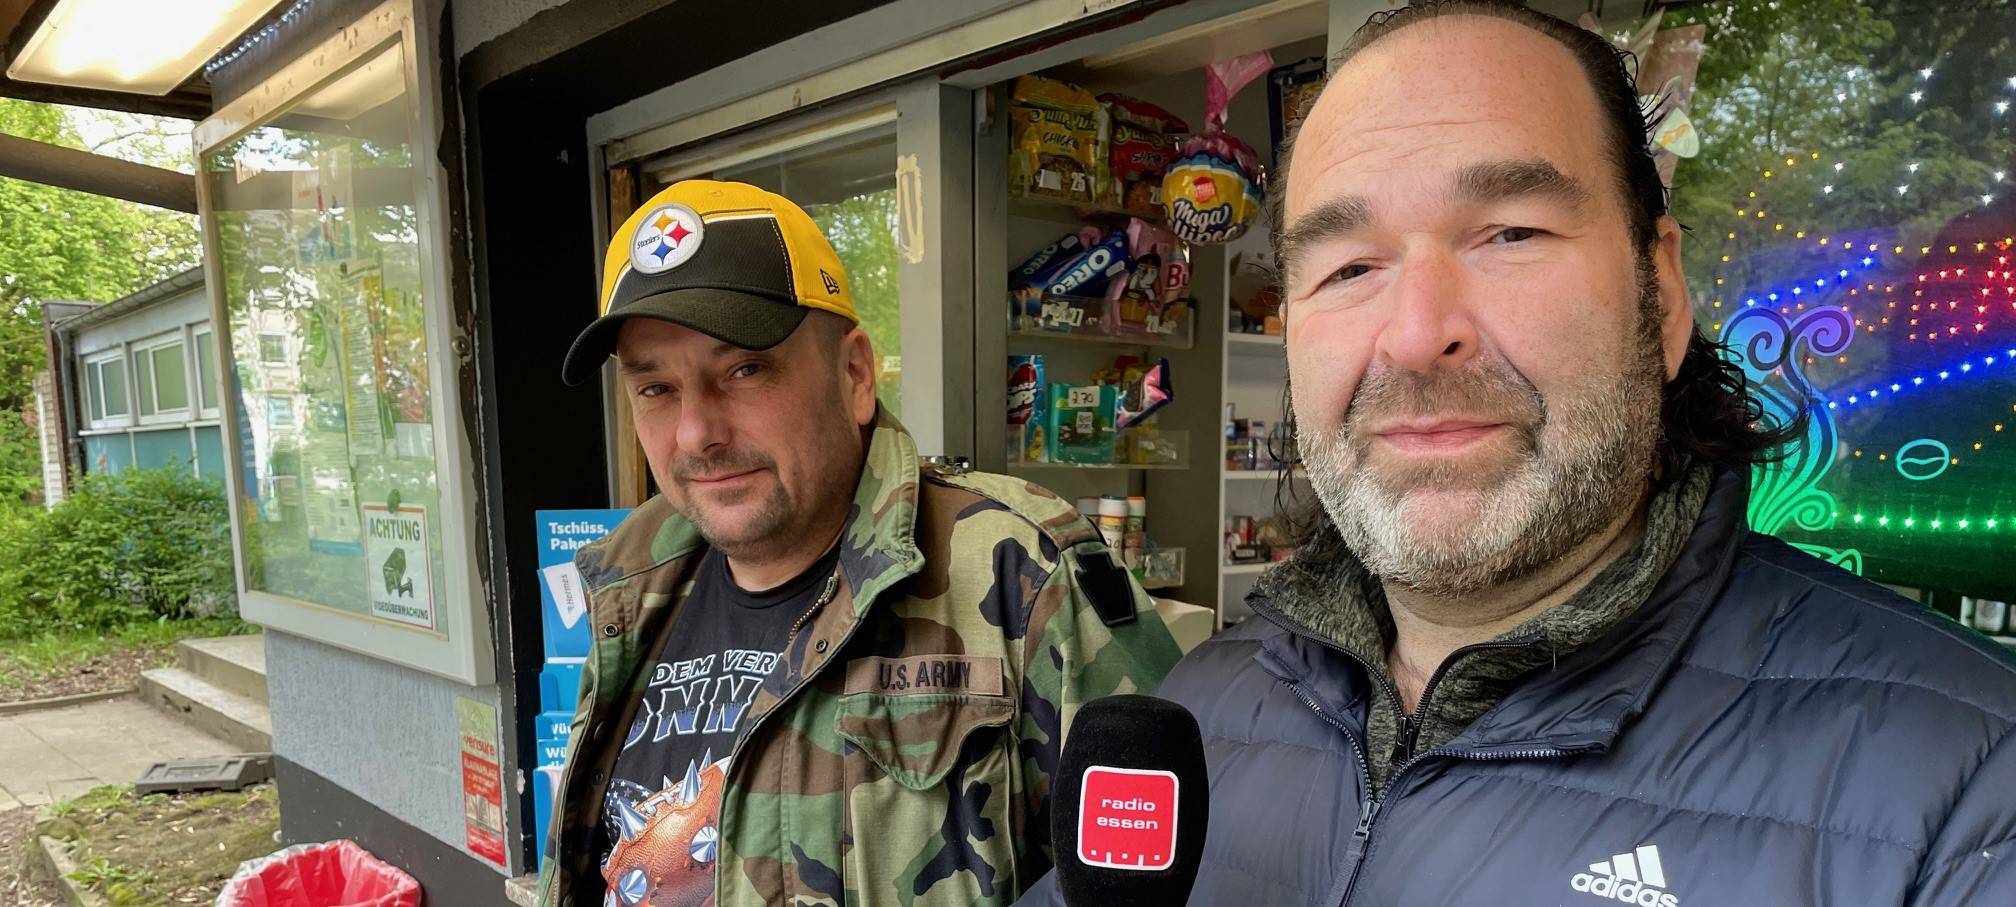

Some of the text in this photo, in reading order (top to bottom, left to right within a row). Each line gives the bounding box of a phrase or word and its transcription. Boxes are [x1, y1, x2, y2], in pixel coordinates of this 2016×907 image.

[1174, 200, 1230, 234] Mega
[1051, 248, 1112, 296] OREO
[369, 517, 421, 541] ACHTUNG
[548, 521, 609, 535] Tschüss,
[373, 600, 429, 621] VIDEOÜBERWACHUNG
[649, 649, 783, 687] DEM VER
[880, 660, 972, 691] U.S. ARMY
[1101, 798, 1156, 812] radio
[1096, 816, 1158, 830] essen
[1570, 873, 1679, 907] adidas
